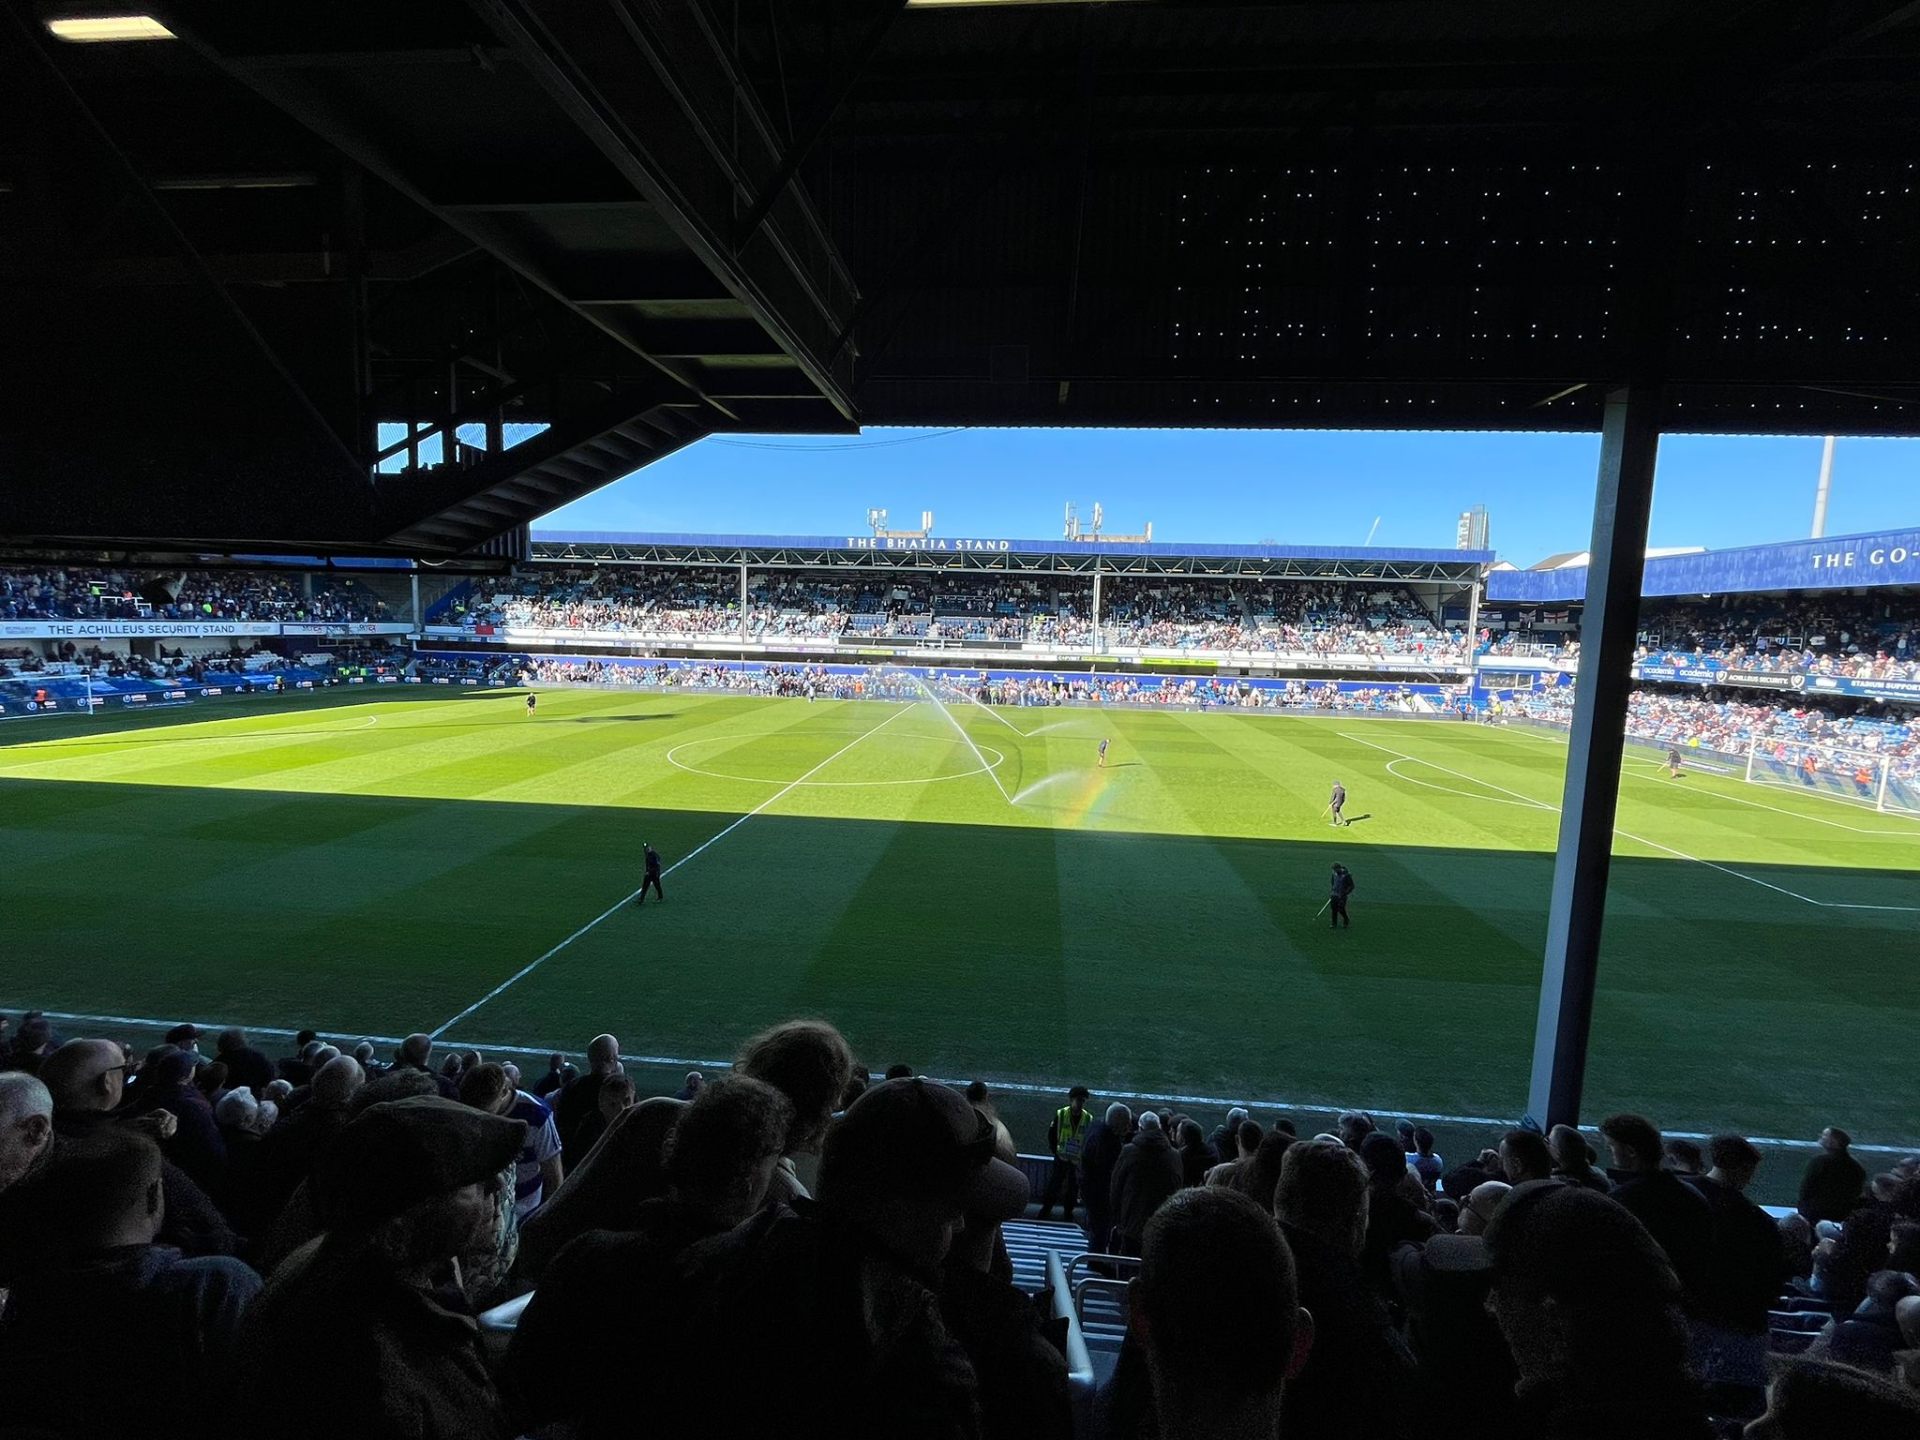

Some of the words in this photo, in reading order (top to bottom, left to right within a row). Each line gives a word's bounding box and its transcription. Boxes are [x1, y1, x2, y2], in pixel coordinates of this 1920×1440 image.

[847, 537, 877, 548] THE
[887, 538, 946, 549] BHATIA
[955, 539, 1009, 550] STAND
[1812, 551, 1855, 569] THE
[48, 625, 74, 634] THE
[78, 624, 145, 634] ACHILLEUS
[148, 624, 200, 634] SECURITY
[202, 624, 235, 634] STAND
